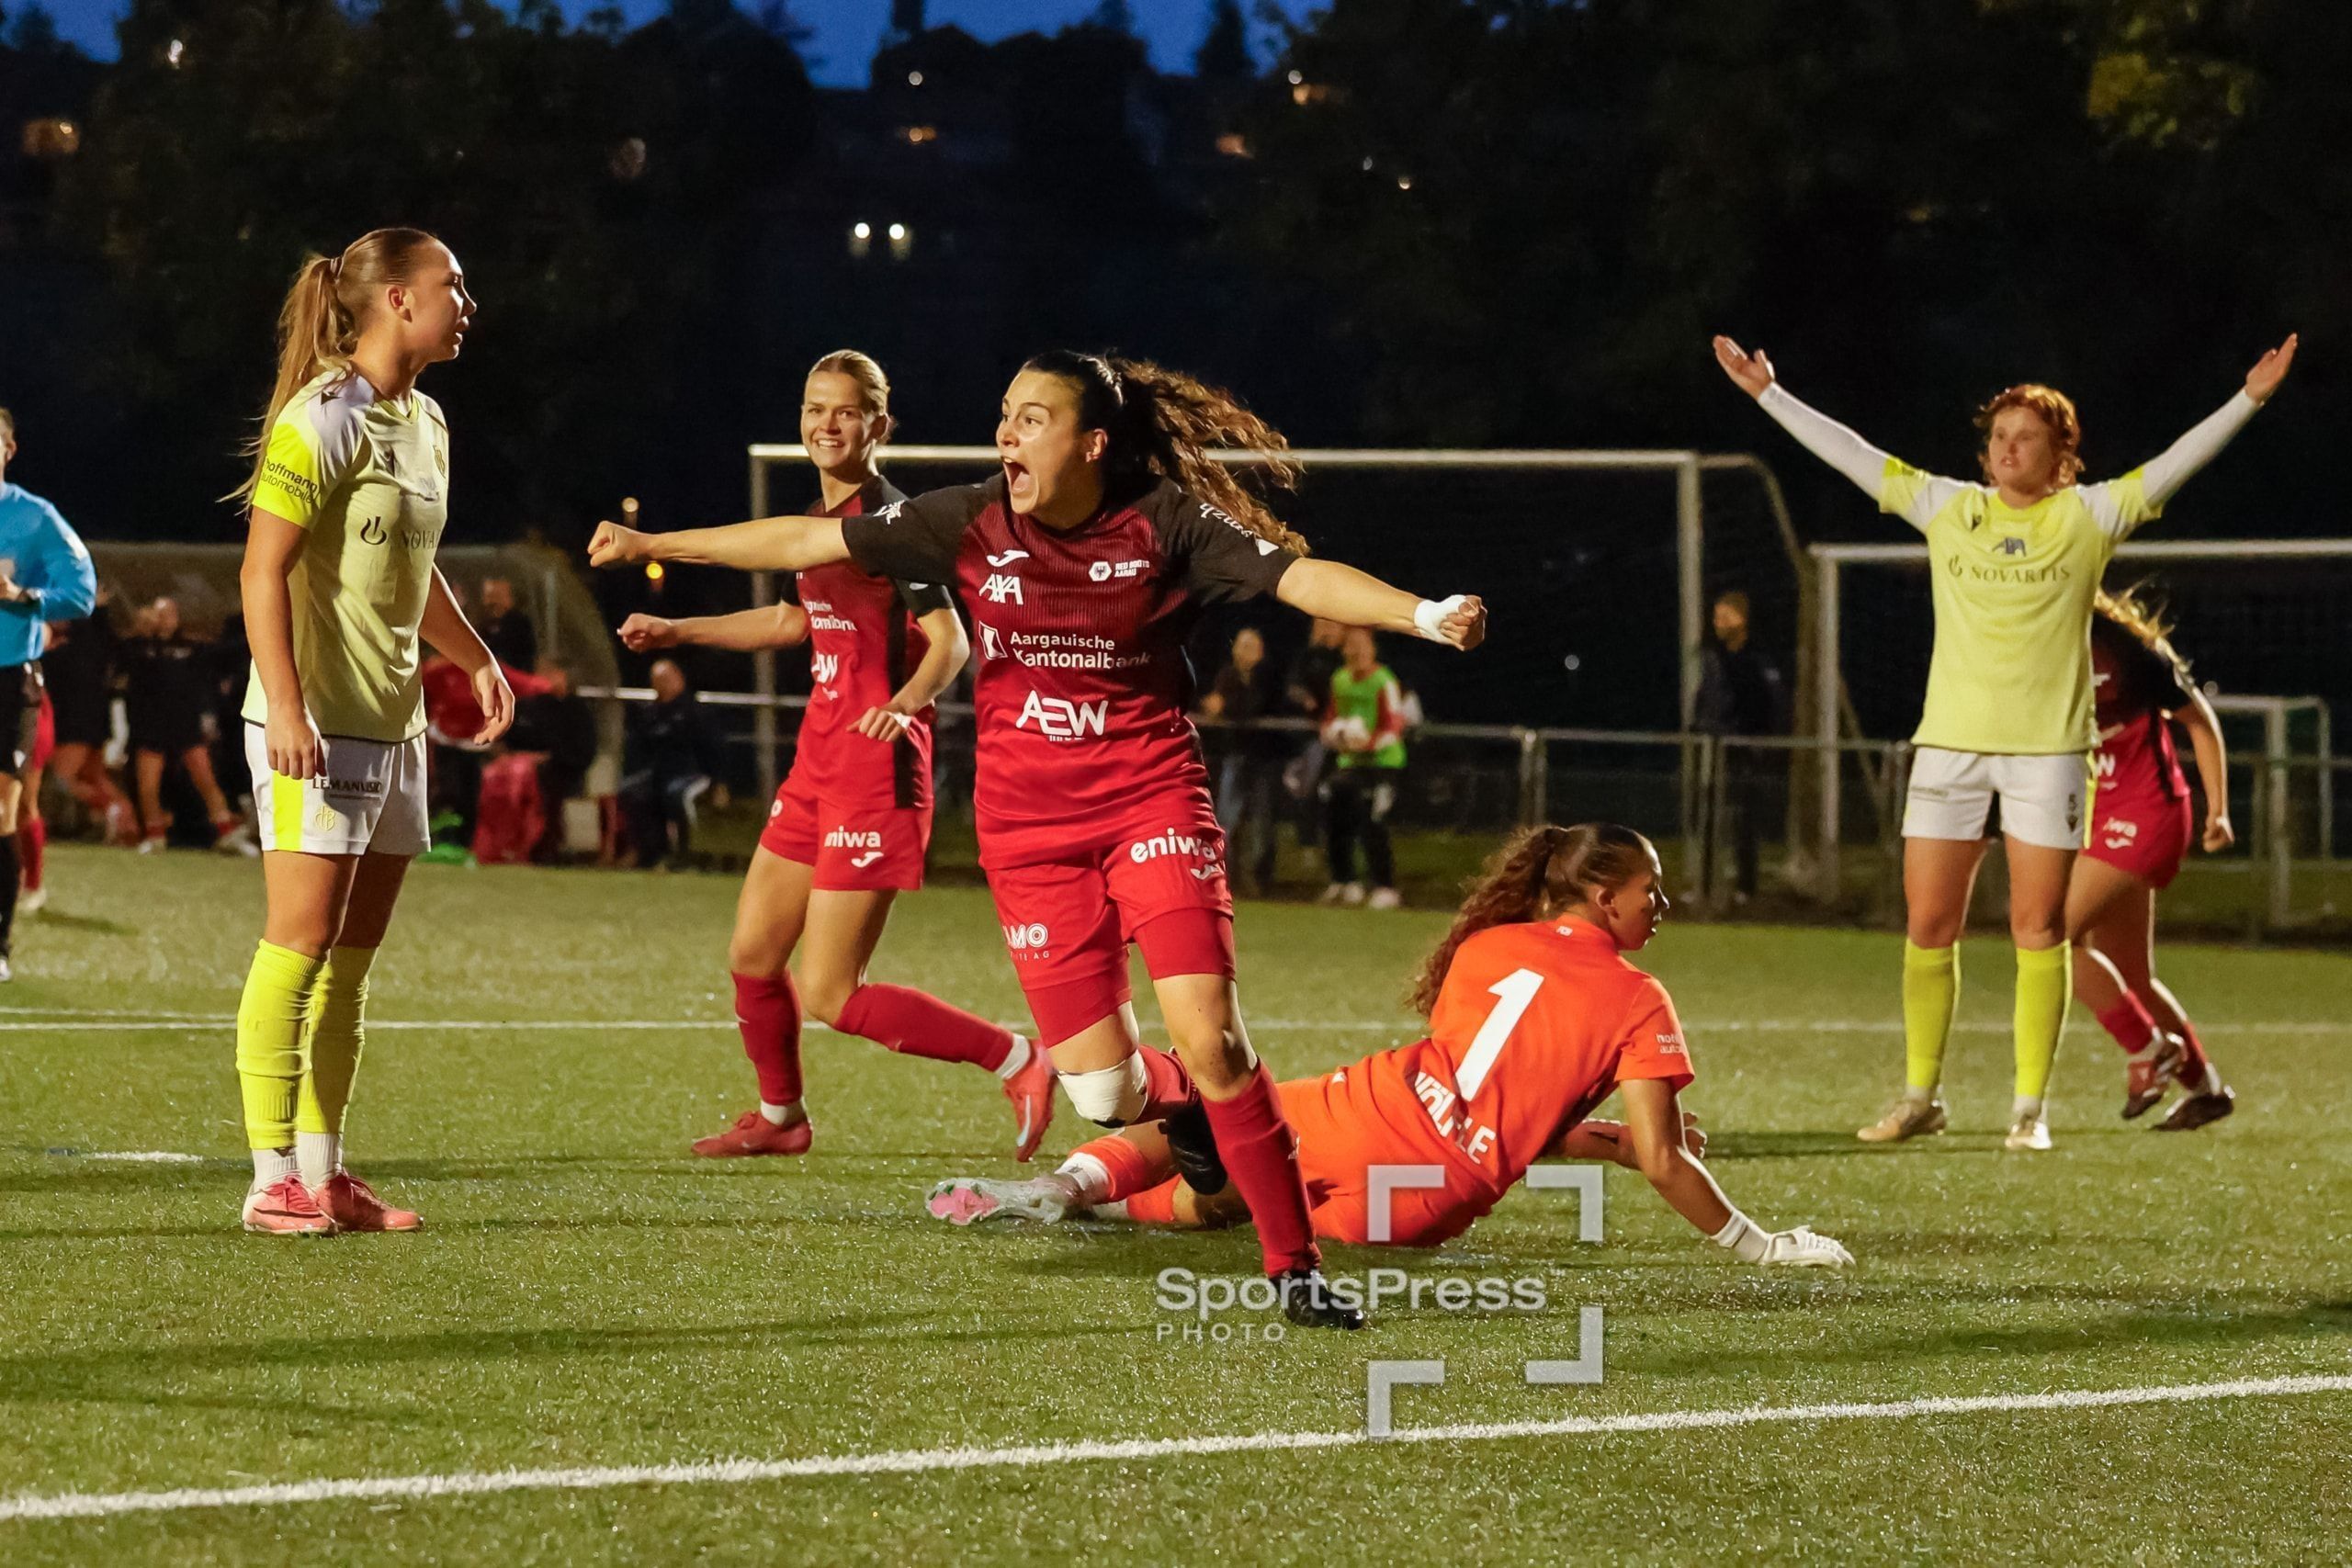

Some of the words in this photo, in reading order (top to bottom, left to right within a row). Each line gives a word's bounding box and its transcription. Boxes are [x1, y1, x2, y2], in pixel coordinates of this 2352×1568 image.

[261, 473, 314, 504] utomobile
[978, 573, 1024, 605] AXA
[1972, 566, 2070, 583] NOVARTIS
[1011, 631, 1115, 650] Aargauische
[1012, 648, 1152, 670] Kantonalbank
[1015, 690, 1109, 737] AEW
[823, 825, 881, 848] niwa
[1130, 827, 1216, 863] eniwa
[1454, 967, 1544, 1102] 1
